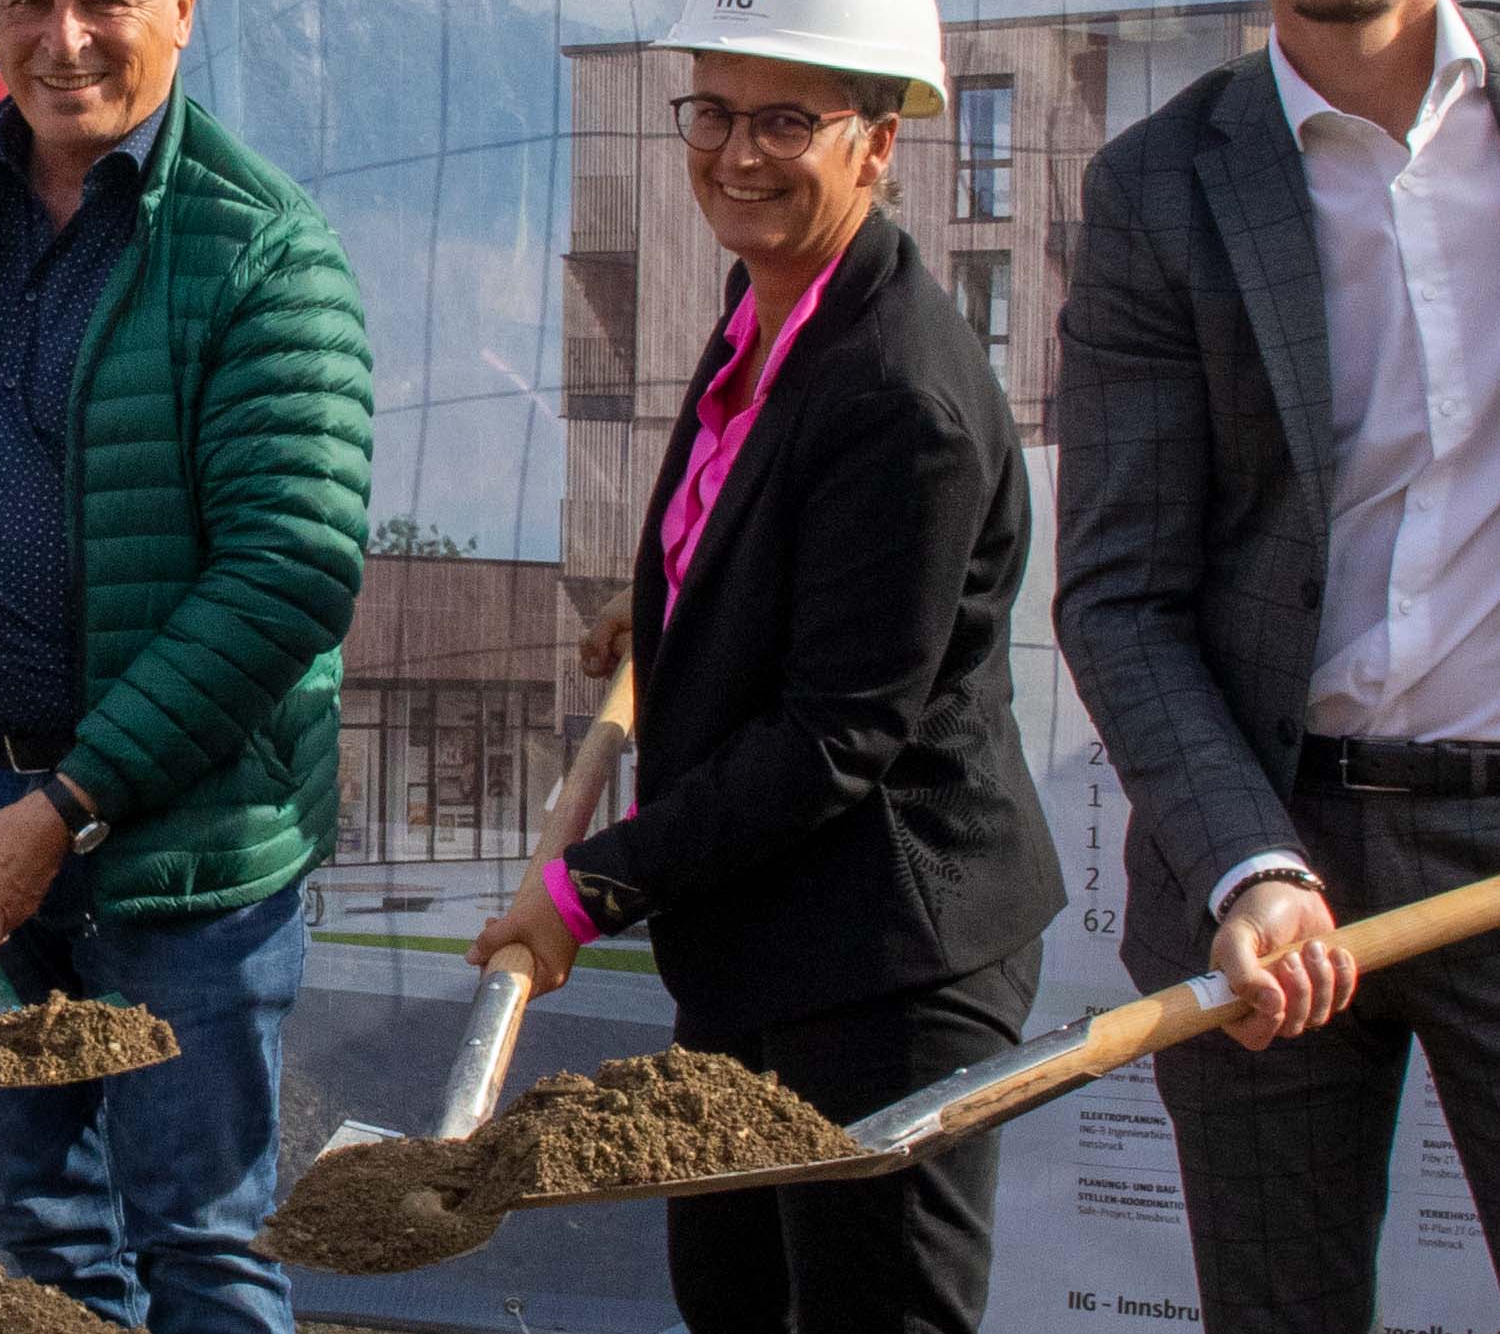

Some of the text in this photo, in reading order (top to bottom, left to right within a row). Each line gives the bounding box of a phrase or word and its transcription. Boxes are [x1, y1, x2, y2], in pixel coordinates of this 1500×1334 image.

[1088, 783, 1102, 807] 1
[1087, 826, 1101, 849] 1
[1085, 867, 1099, 890] 2
[1084, 908, 1116, 933] 62
[1132, 1183, 1154, 1192] UND
[1067, 1290, 1200, 1322] IIG Innsbru
